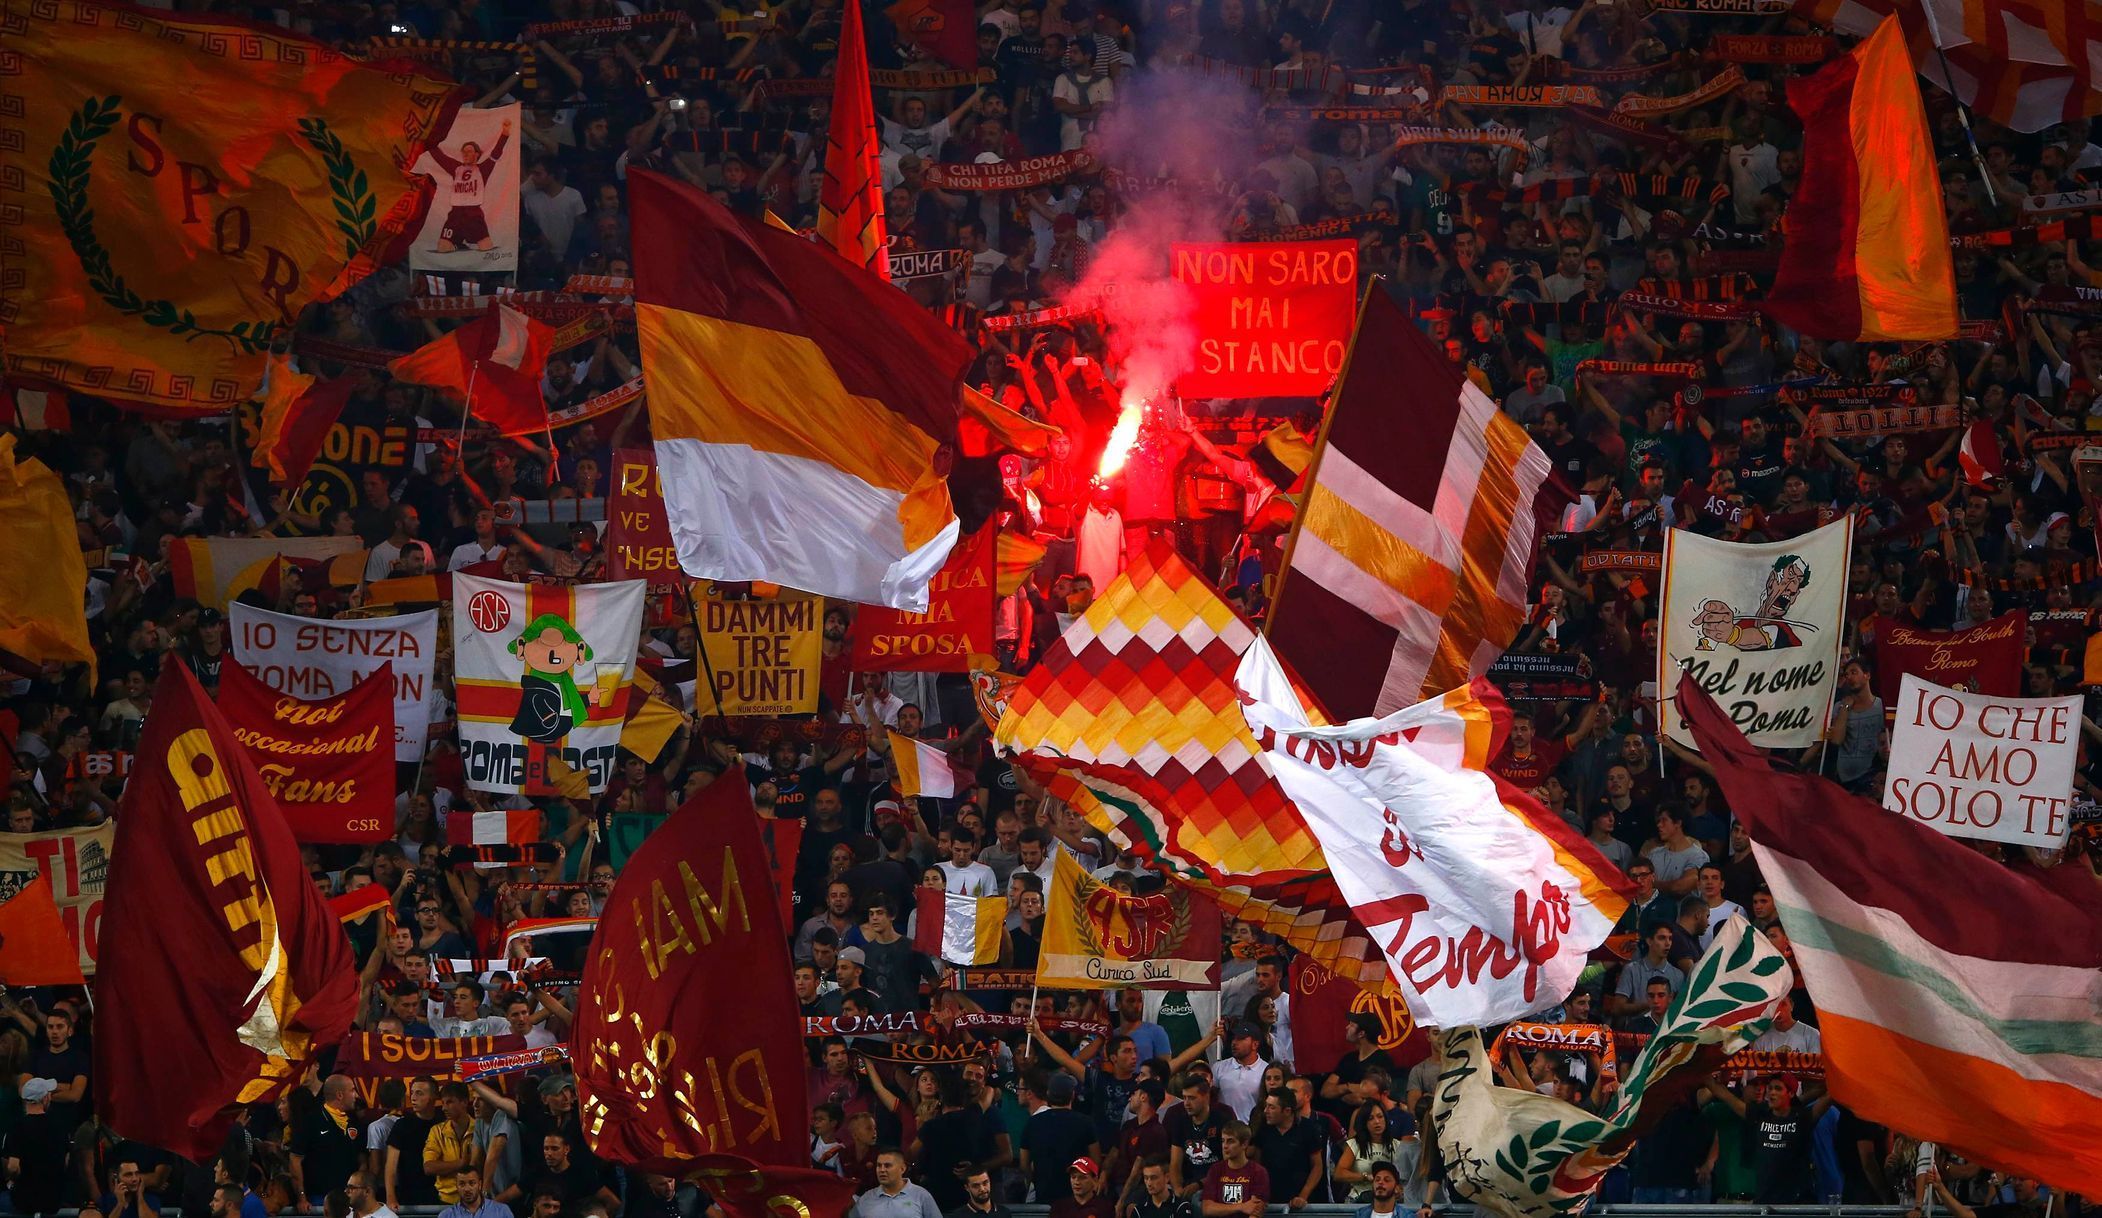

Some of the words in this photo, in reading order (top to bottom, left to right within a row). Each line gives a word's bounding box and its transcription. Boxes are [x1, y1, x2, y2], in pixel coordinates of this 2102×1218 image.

[1728, 40, 1769, 56] FORZA
[1785, 42, 1824, 57] ROMA
[1312, 110, 1401, 120] roma
[1608, 111, 1648, 131] ROMA
[1399, 127, 1442, 142] URVA
[1485, 127, 1528, 145] ROM
[462, 169, 472, 180] 6
[949, 164, 977, 176] CHI
[983, 161, 1016, 176] TIFA
[1020, 155, 1067, 171] ROMA
[948, 177, 983, 188] NON
[988, 171, 1034, 187] PERDE
[2056, 192, 2088, 206] AS
[889, 252, 943, 277] ROMA
[1178, 250, 1255, 285] NON
[1231, 297, 1291, 330] MAI
[1201, 338, 1347, 374] STANCO
[1861, 386, 1889, 398] 1927
[620, 511, 651, 532] VE
[1586, 555, 1657, 567] ODIATI
[469, 592, 511, 632] ASR
[706, 600, 815, 634] DAMMI
[897, 600, 956, 625] MIA
[243, 622, 277, 650] IO
[296, 625, 420, 659] SENZA
[731, 635, 792, 668] TRE
[870, 633, 976, 656] SPOSA
[1924, 649, 1979, 672] Roma
[716, 668, 805, 702] PUNTI
[1742, 659, 1827, 697] nome
[752, 704, 785, 714] SCAPPATE
[1912, 687, 1966, 732] IO
[1977, 704, 2070, 745] CHE
[1500, 767, 1540, 778] WIND
[1925, 738, 2039, 788] AMO
[257, 762, 357, 804] Fans
[1888, 777, 2003, 830] SOLO
[2017, 793, 2068, 837] TE
[346, 818, 381, 833] CSR
[1086, 886, 1175, 959] ASR
[1143, 960, 1172, 980] Sud
[1159, 1002, 1193, 1016] Carlsberg
[806, 1010, 920, 1035] ROMA
[1506, 1024, 1602, 1048] ROMA
[1507, 1038, 1555, 1049] CAPUT
[891, 1039, 988, 1061] ROMA
